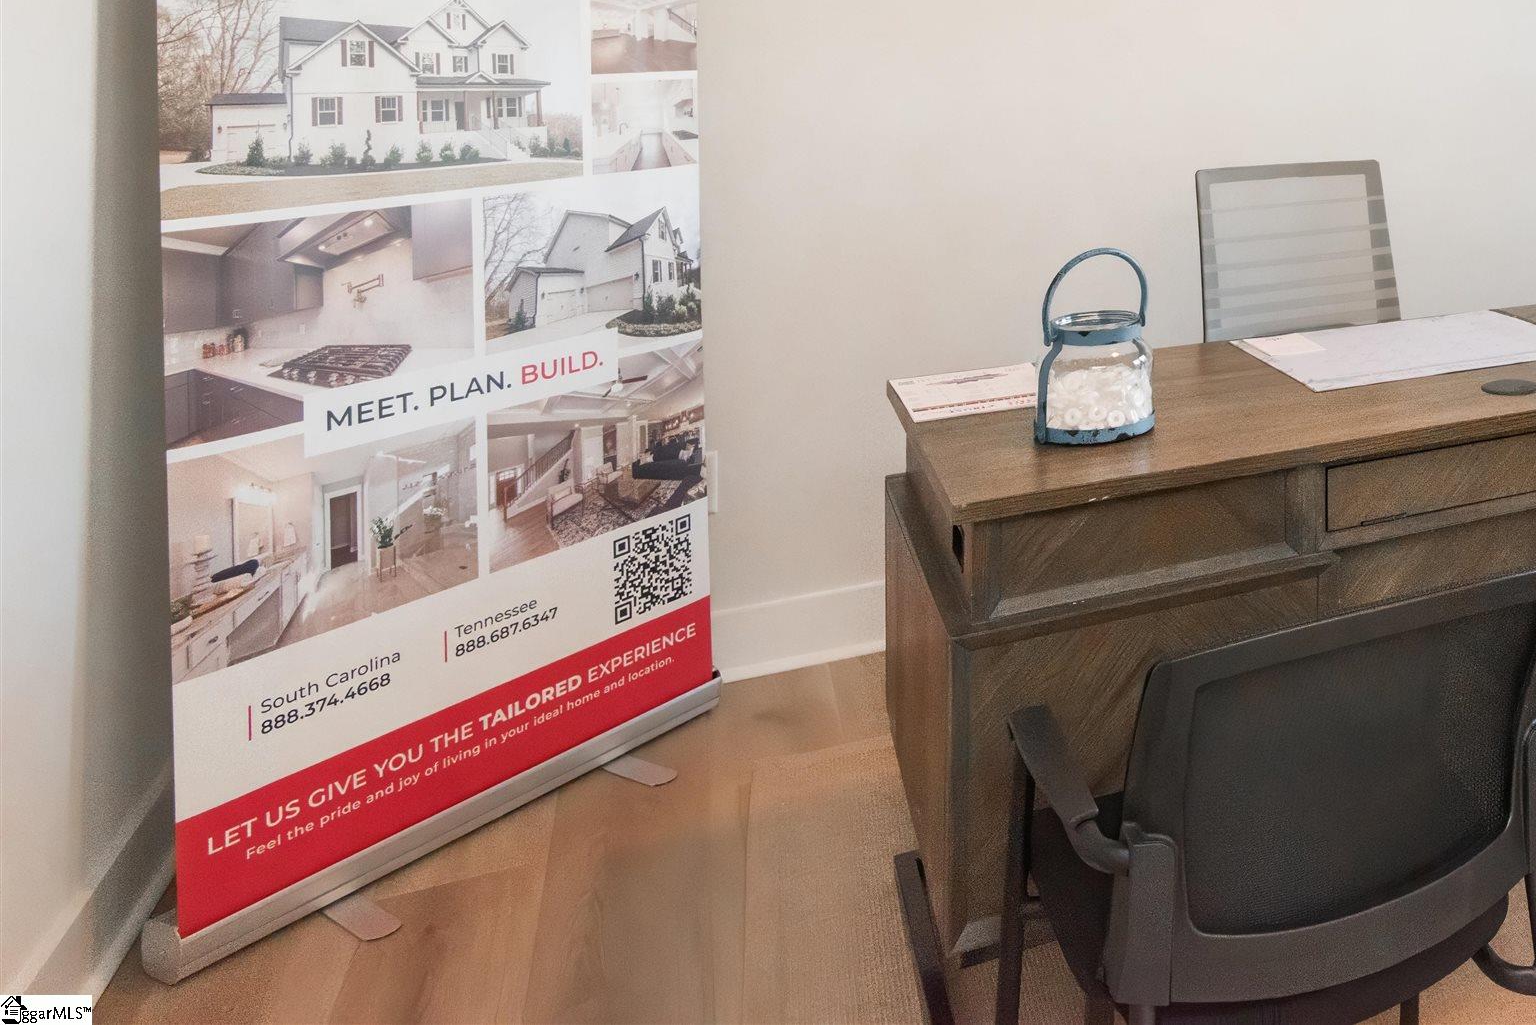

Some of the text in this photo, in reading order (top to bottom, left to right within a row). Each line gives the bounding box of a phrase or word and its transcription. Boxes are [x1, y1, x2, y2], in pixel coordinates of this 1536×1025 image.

[326, 350, 604, 432] MEET. PLAN. BUILD.
[454, 598, 538, 639] Tennessee
[455, 606, 559, 657] 888.687.6347
[260, 651, 401, 714] South Carolina
[260, 672, 392, 735] 888.374.4668
[207, 622, 698, 856] LET US GIVE YOU THE TAILORED EXPERIENCE
[246, 655, 676, 860] Feel the pride and joy of living in your ideal home and location.
